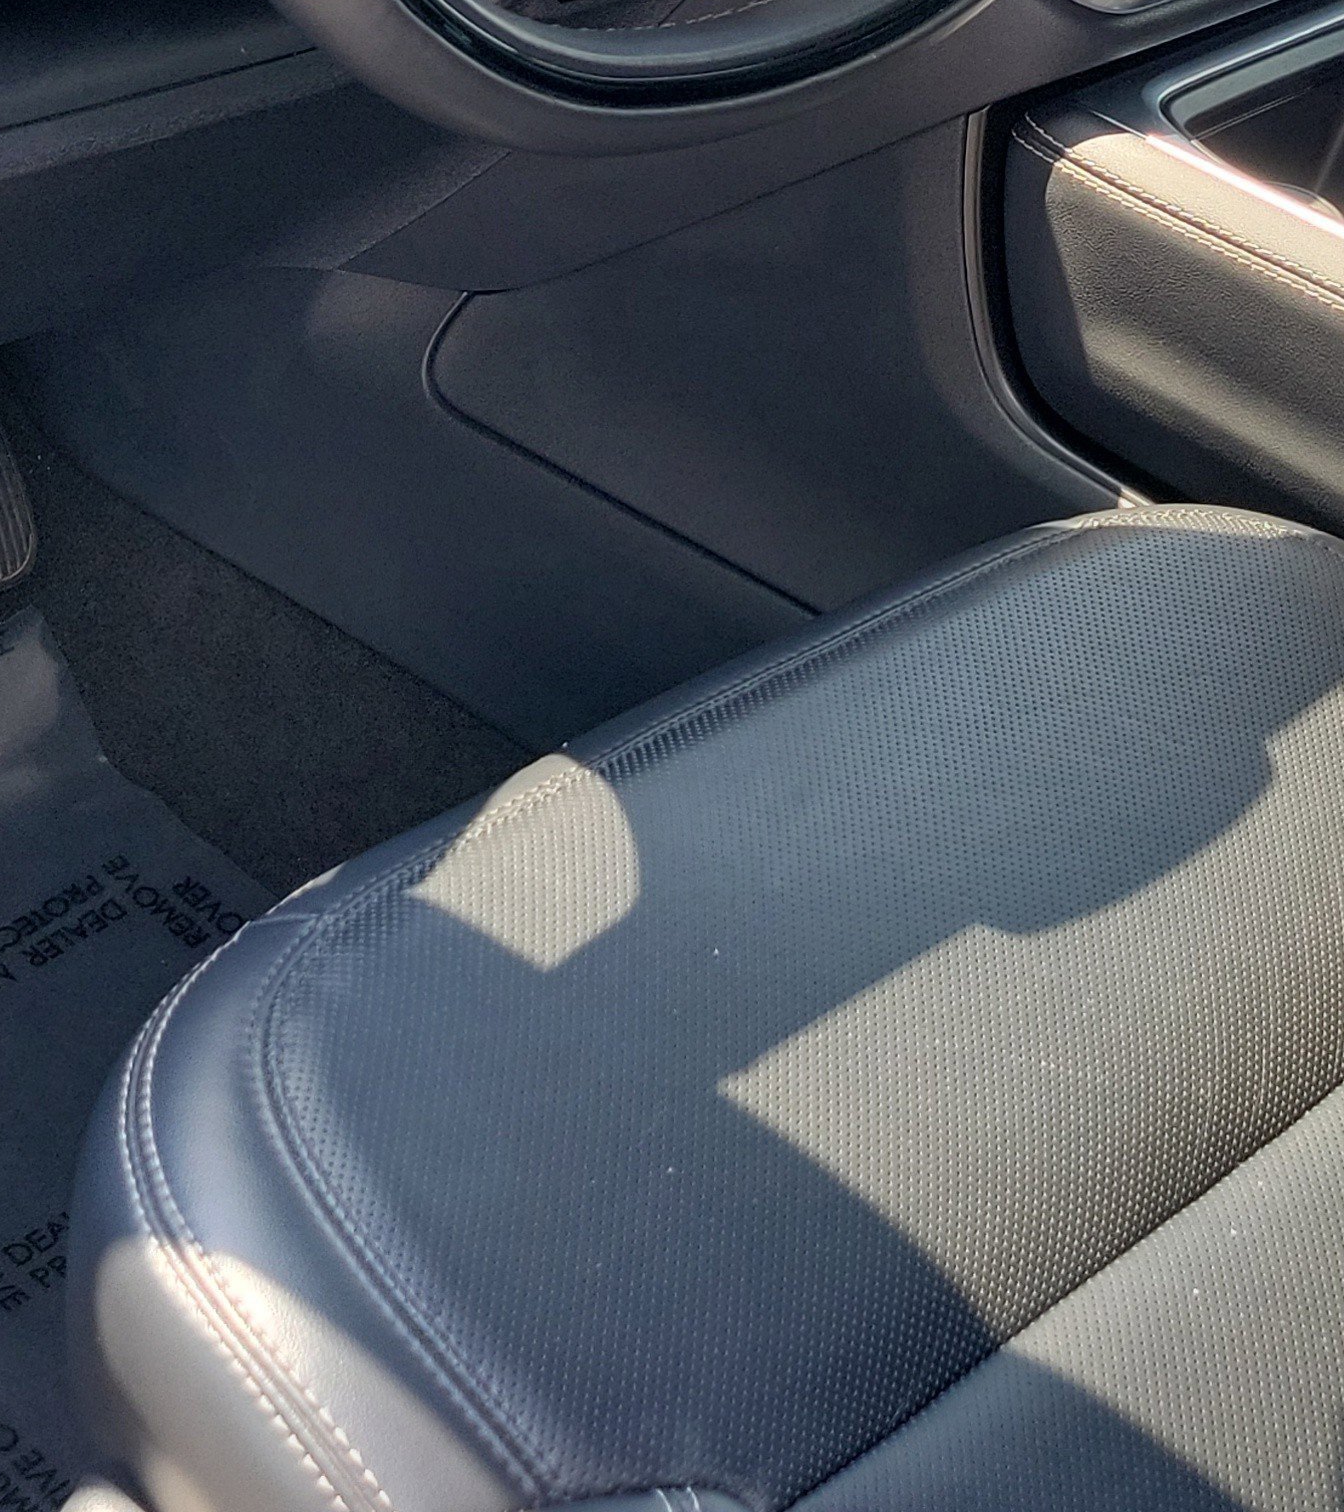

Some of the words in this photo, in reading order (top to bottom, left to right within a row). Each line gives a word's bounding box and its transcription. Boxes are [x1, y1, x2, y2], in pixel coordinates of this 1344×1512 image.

[22, 894, 130, 969] DEALER
[102, 854, 212, 949] REMOVE
[172, 876, 244, 934] OVER
